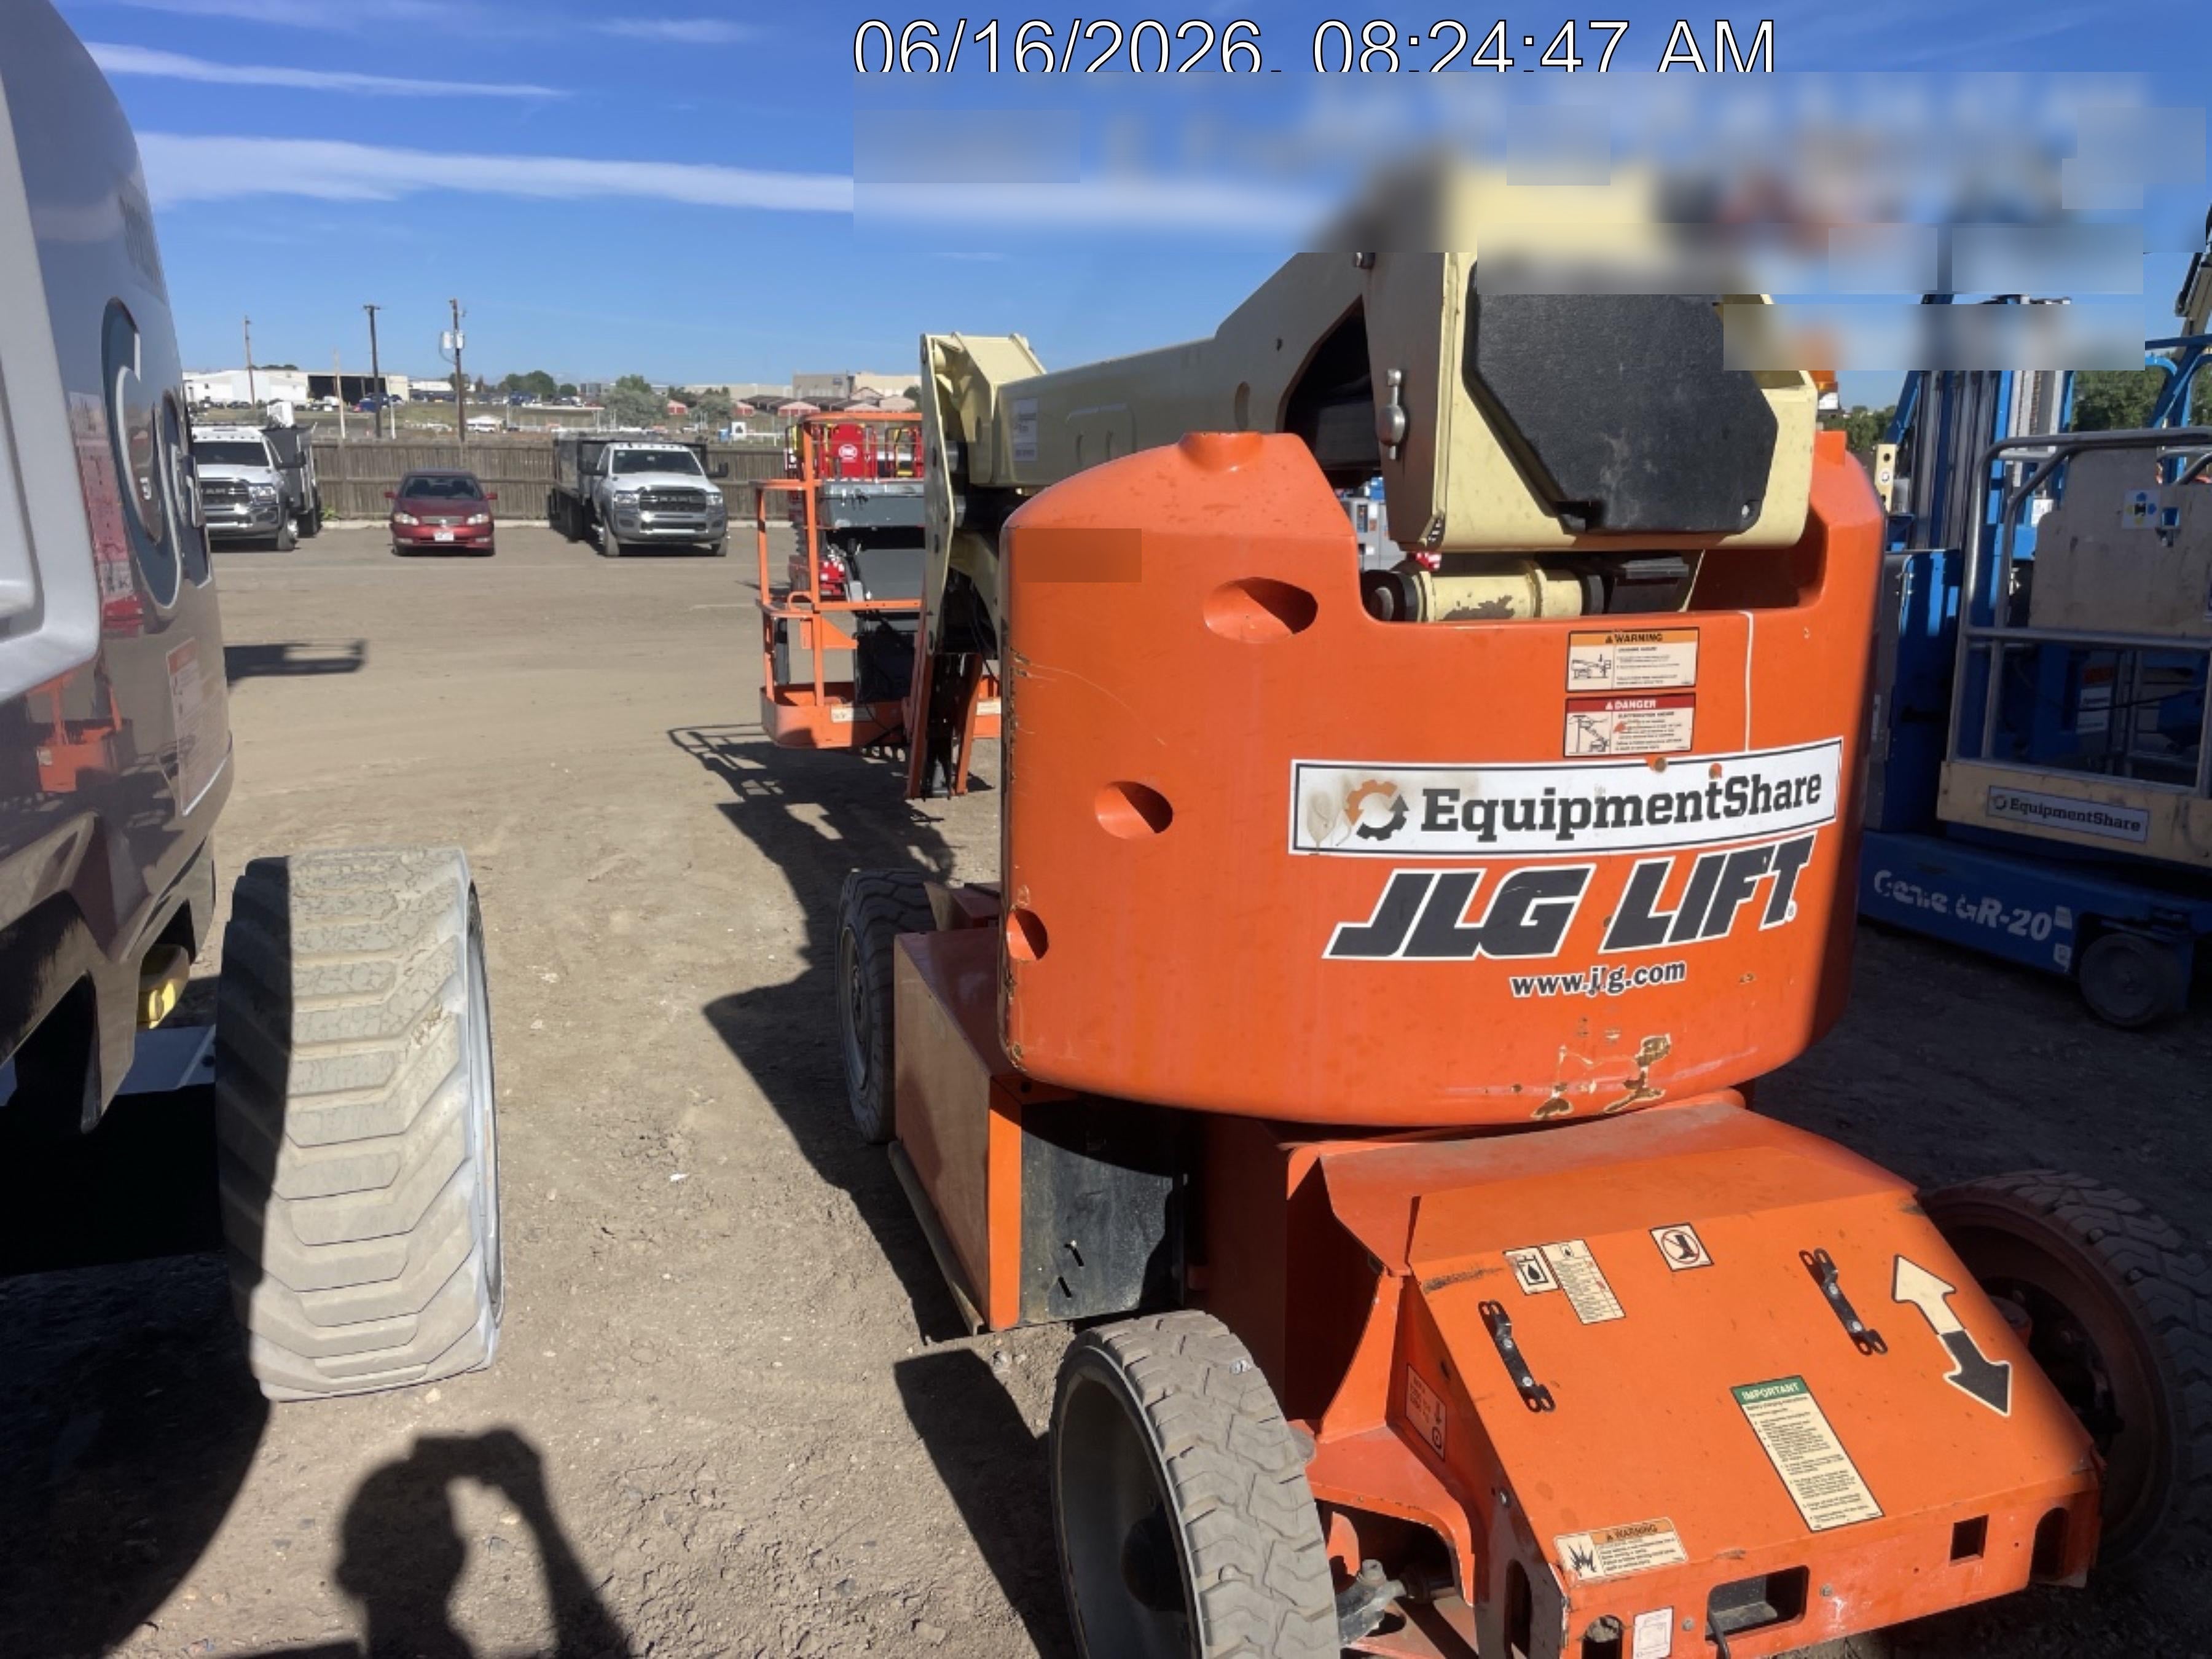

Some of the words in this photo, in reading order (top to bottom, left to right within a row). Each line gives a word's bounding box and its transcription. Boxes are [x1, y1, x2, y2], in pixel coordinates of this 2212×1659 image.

[1614, 633, 1663, 643] WARNING
[1614, 699, 1657, 710] DANGER
[1420, 772, 1821, 842] EquipmentShare
[2009, 797, 2141, 832] EquipmentShare
[1322, 863, 1596, 960] JLG
[1599, 833, 1817, 954] LIFT
[1741, 1382, 1800, 1400] IMPORTANT
